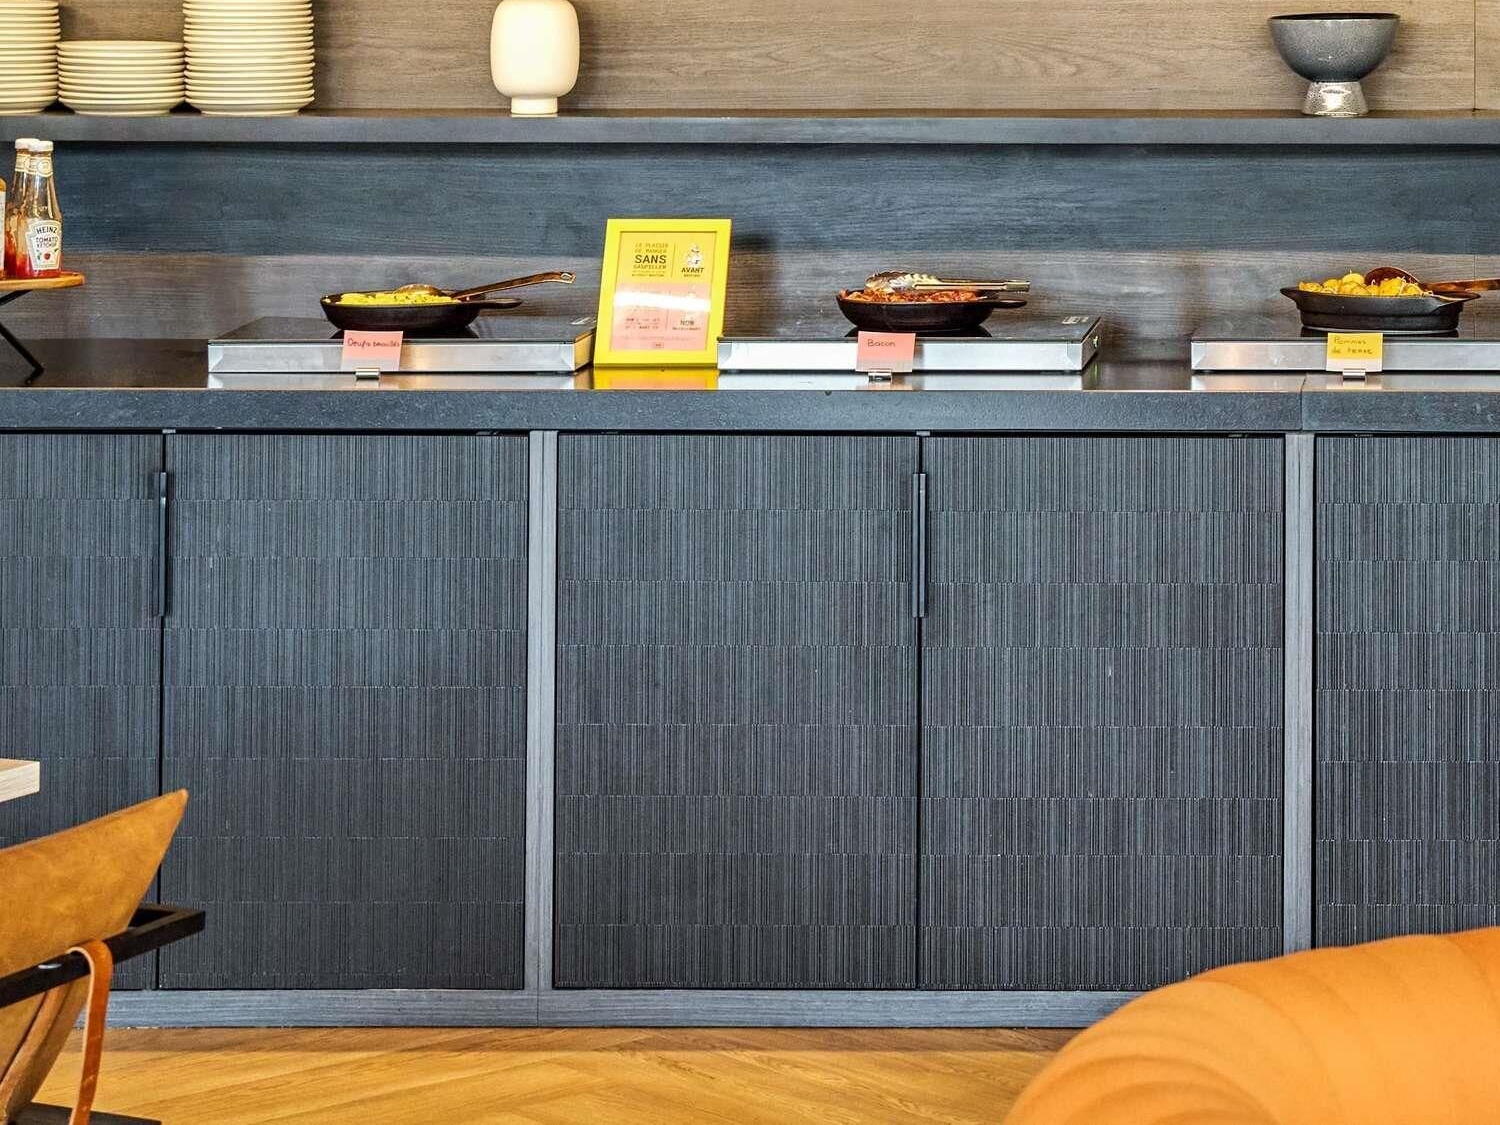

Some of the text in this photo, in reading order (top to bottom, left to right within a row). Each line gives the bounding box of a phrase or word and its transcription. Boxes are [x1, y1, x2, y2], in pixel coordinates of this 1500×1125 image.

[36, 225, 57, 235] HEINZ
[634, 255, 667, 264] SANS
[867, 338, 896, 348] Bacon
[1334, 336, 1367, 345] Pommes
